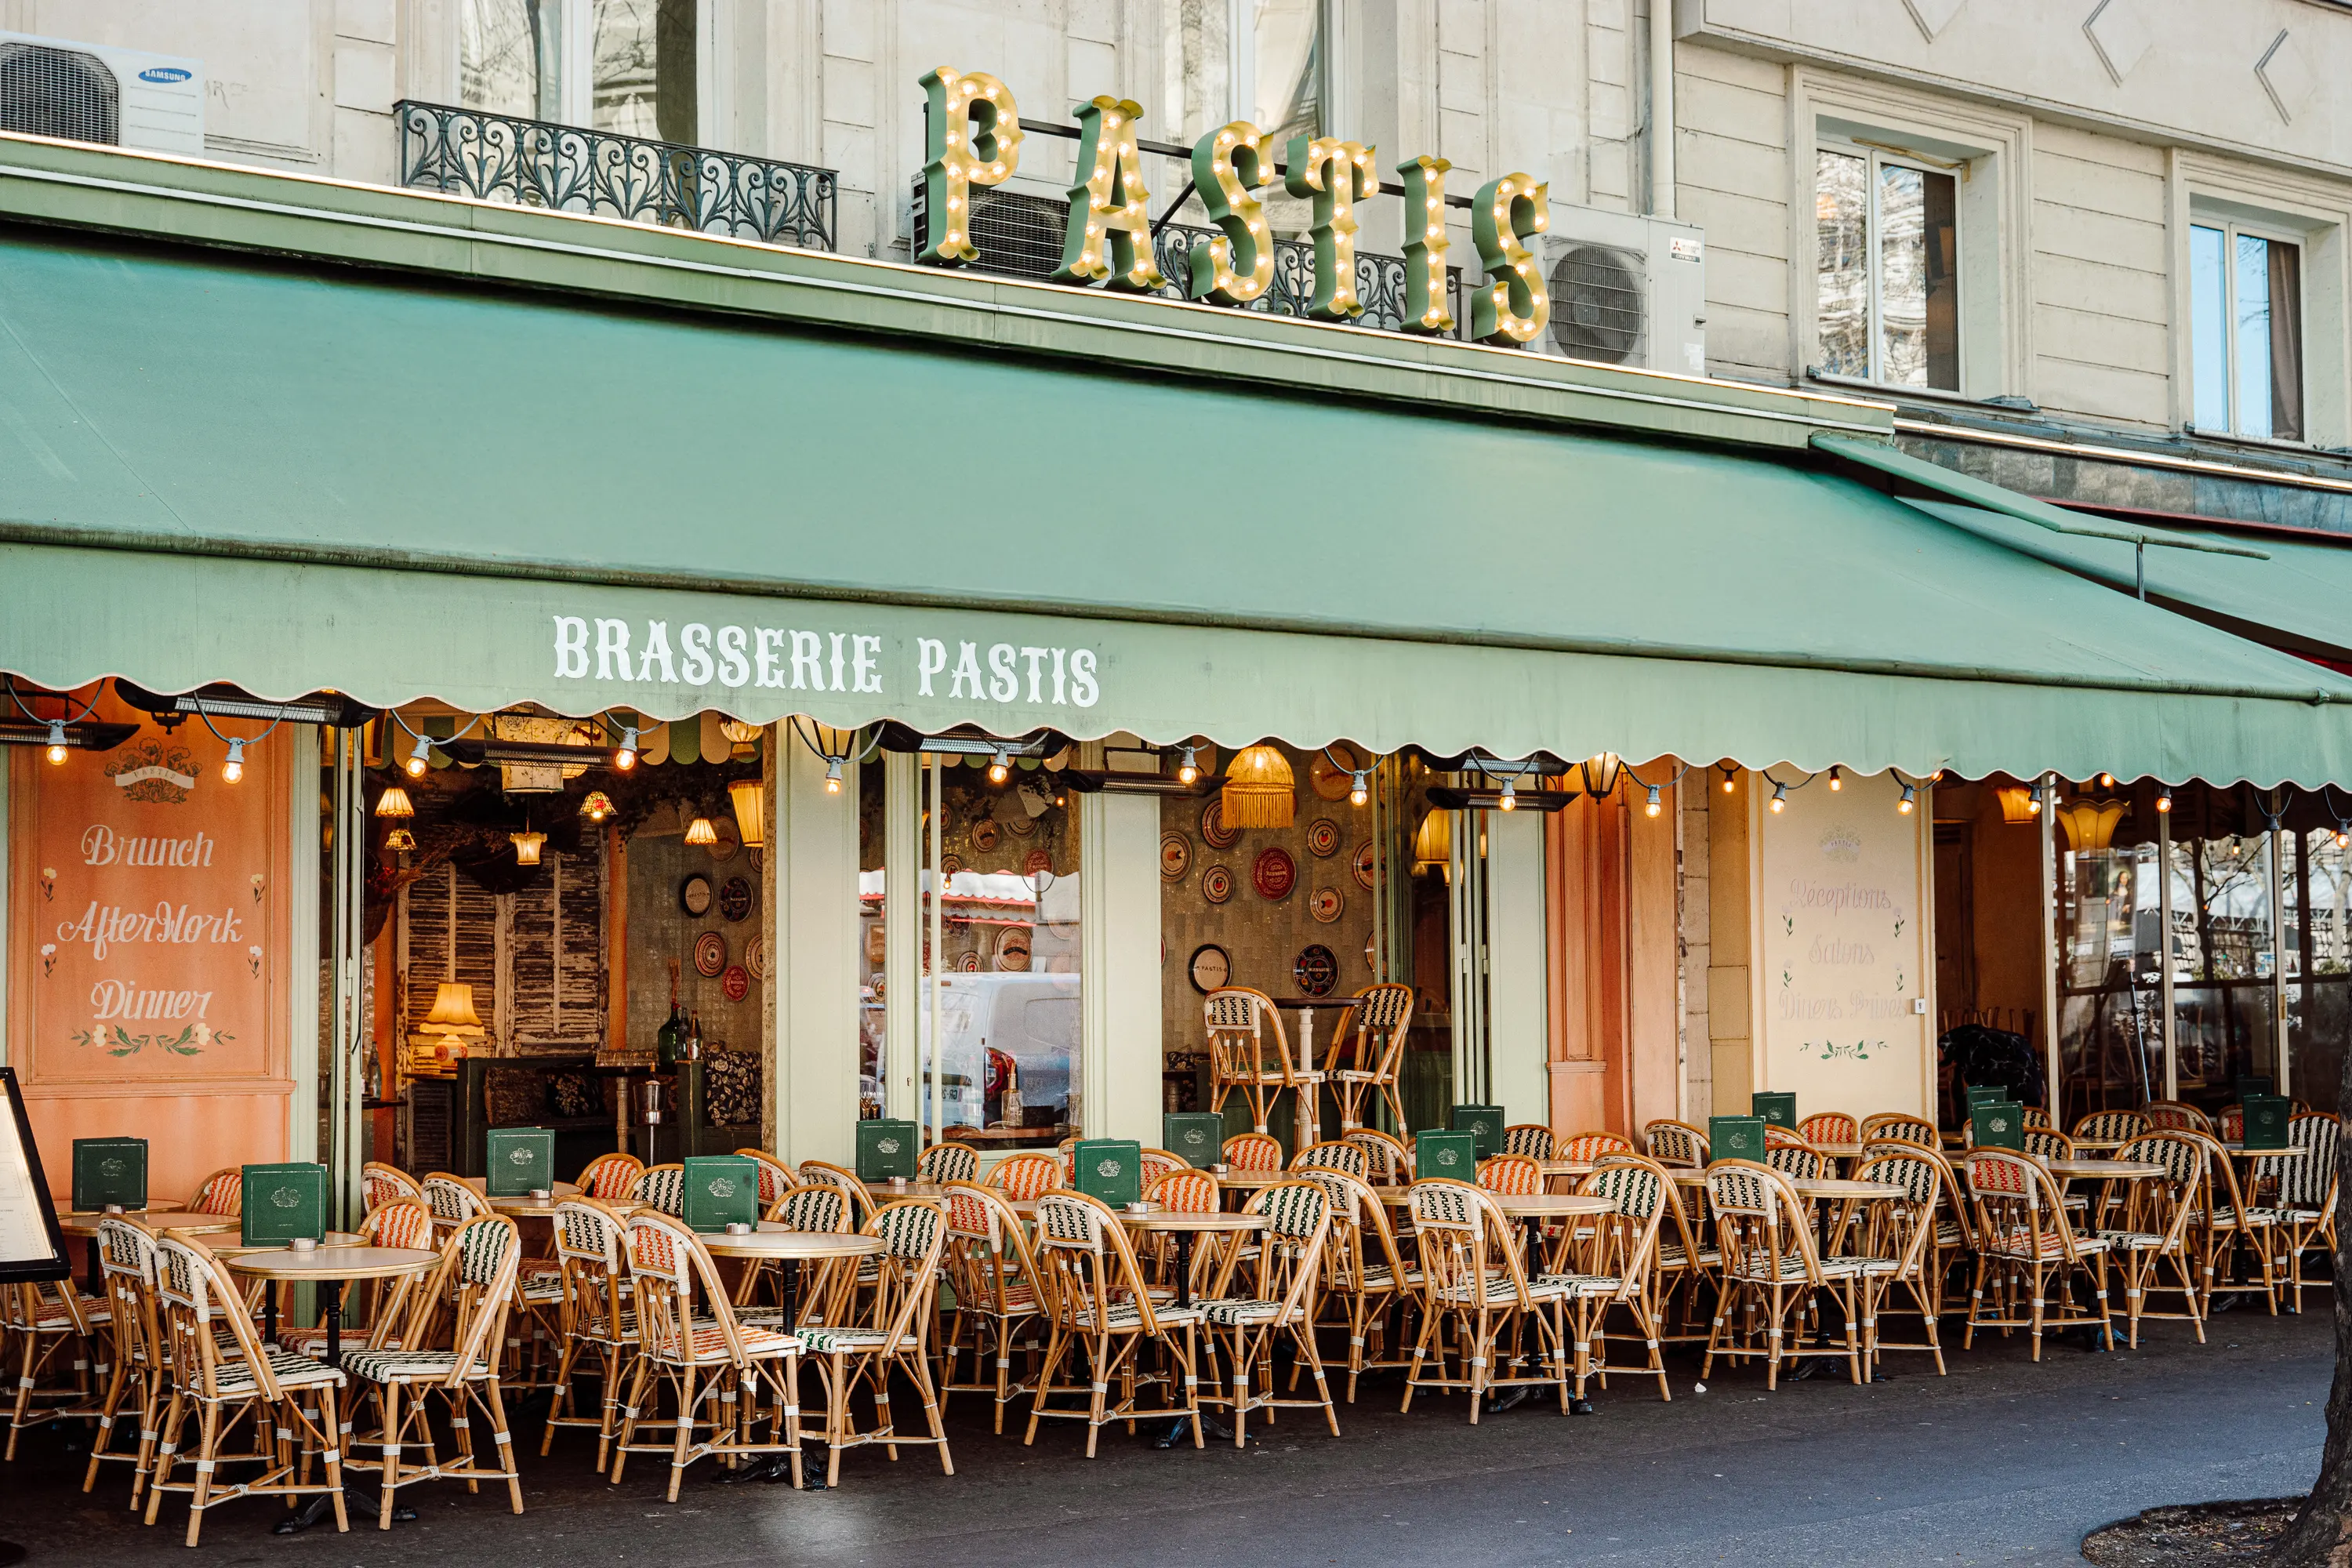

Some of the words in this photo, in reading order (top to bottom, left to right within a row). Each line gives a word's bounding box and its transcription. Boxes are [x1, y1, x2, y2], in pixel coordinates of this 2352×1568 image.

[145, 70, 186, 82] SAMSUNG
[918, 66, 1550, 346] PASTIS
[553, 615, 884, 695] BRASSERIE
[917, 637, 1100, 708] PASTIS
[133, 768, 176, 779] PASTIS
[81, 824, 215, 868] Brunch
[1790, 878, 1892, 918] Réceptions
[1808, 934, 1875, 965] Salons
[90, 978, 213, 1020] Dinner
